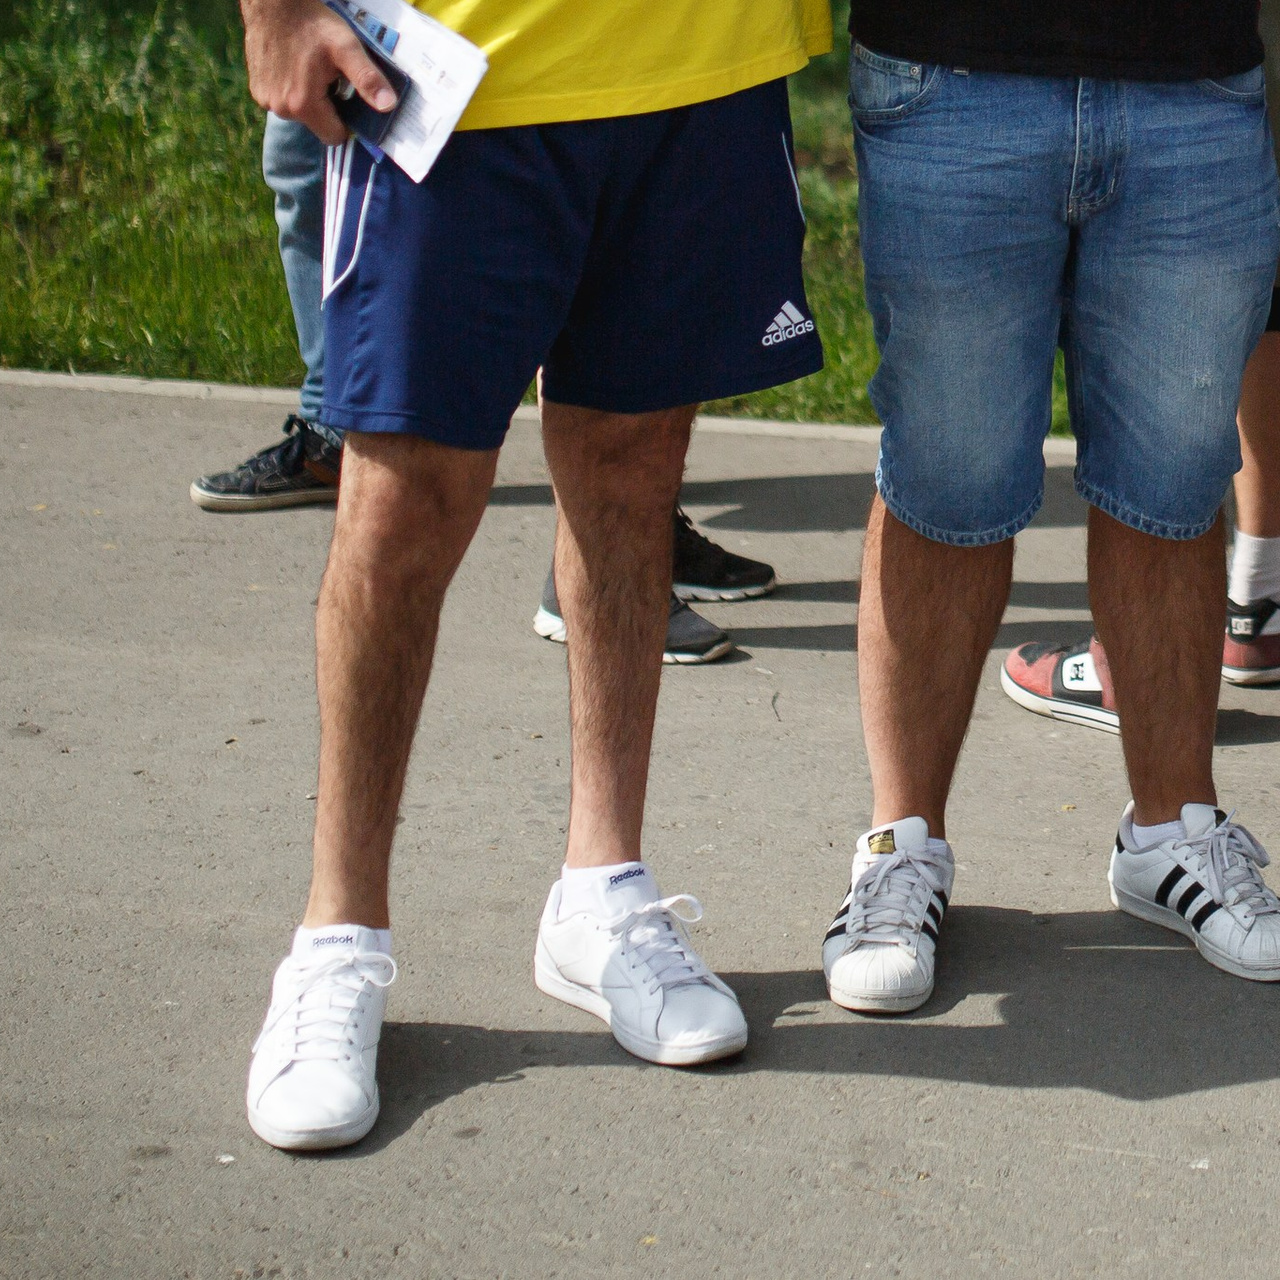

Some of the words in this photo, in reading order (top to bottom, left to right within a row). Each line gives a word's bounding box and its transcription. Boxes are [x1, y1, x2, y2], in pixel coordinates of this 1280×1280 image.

[762, 320, 814, 346] adidas
[609, 868, 645, 885] Reebok
[312, 935, 353, 948] Reebok
